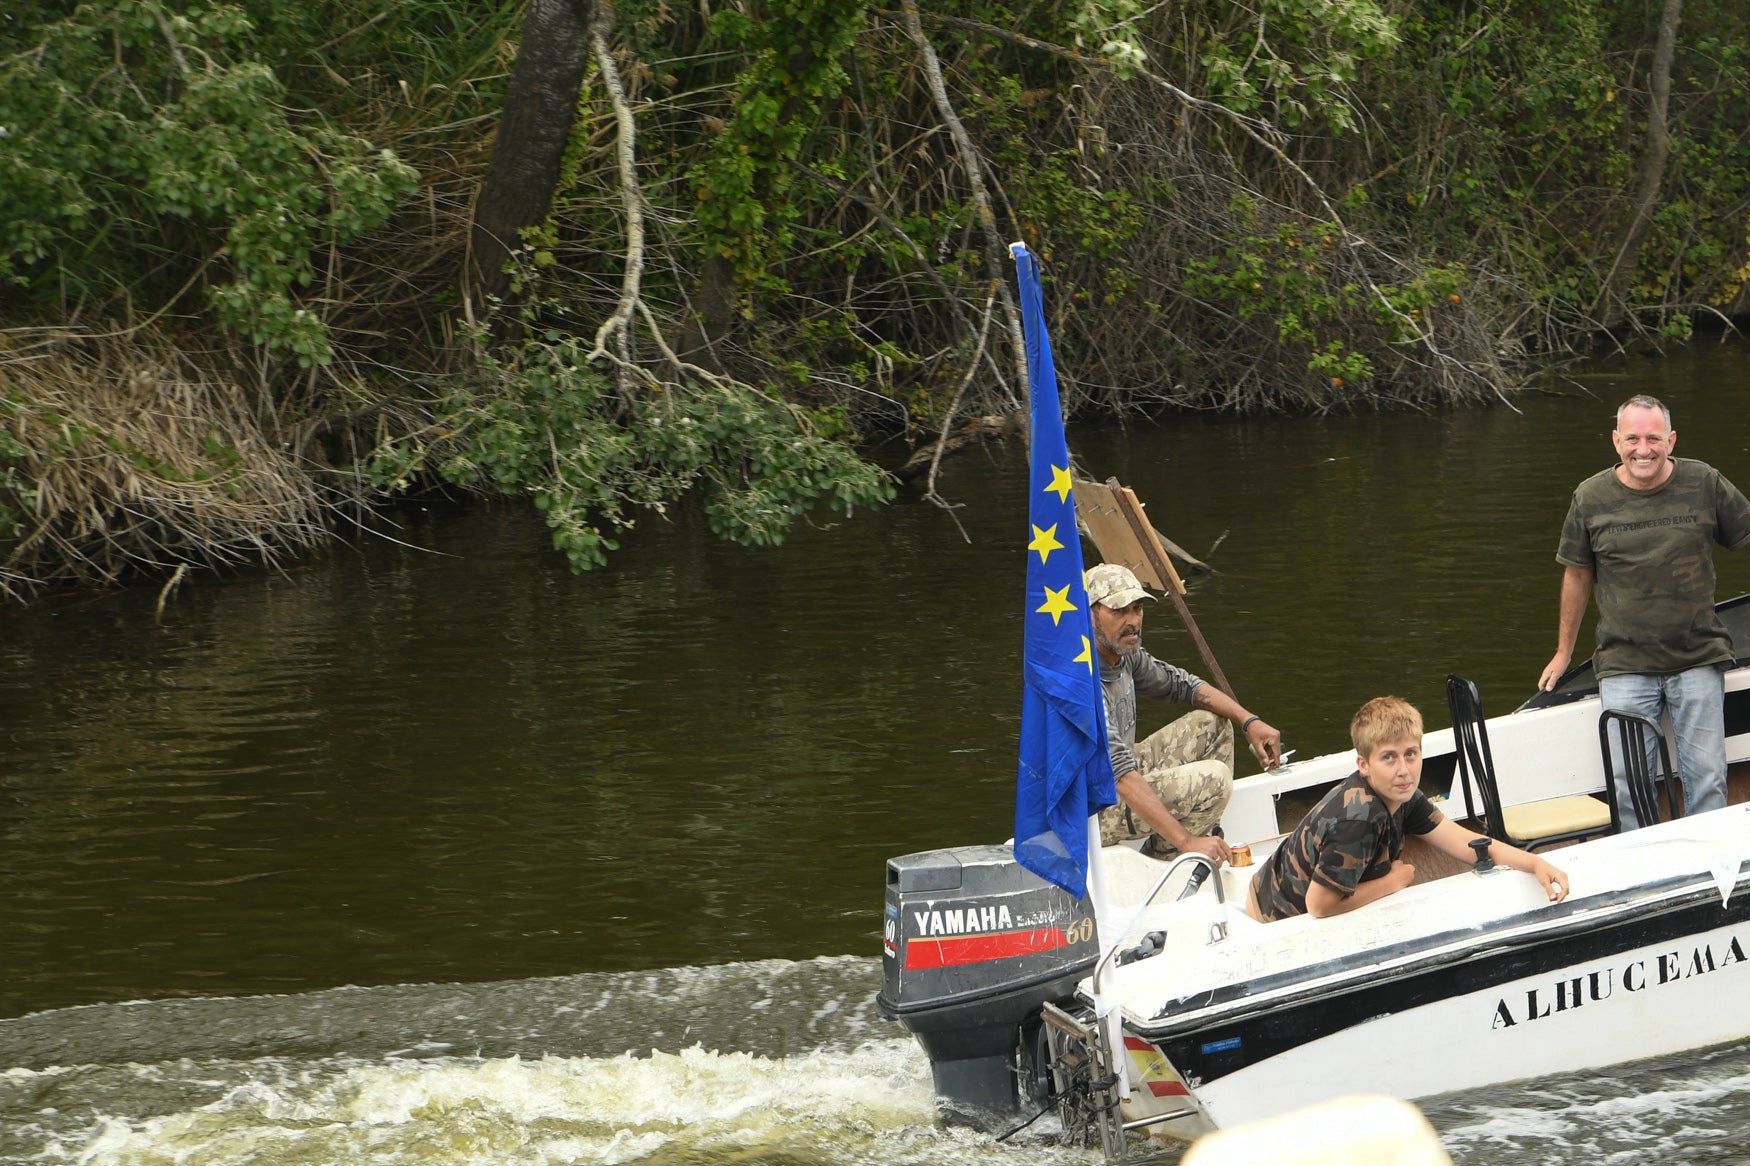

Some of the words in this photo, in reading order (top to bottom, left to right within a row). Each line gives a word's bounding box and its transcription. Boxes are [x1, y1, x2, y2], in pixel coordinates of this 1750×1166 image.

[885, 918, 896, 943] 60
[914, 905, 1013, 936] YAMAHA
[1066, 917, 1094, 945] 60
